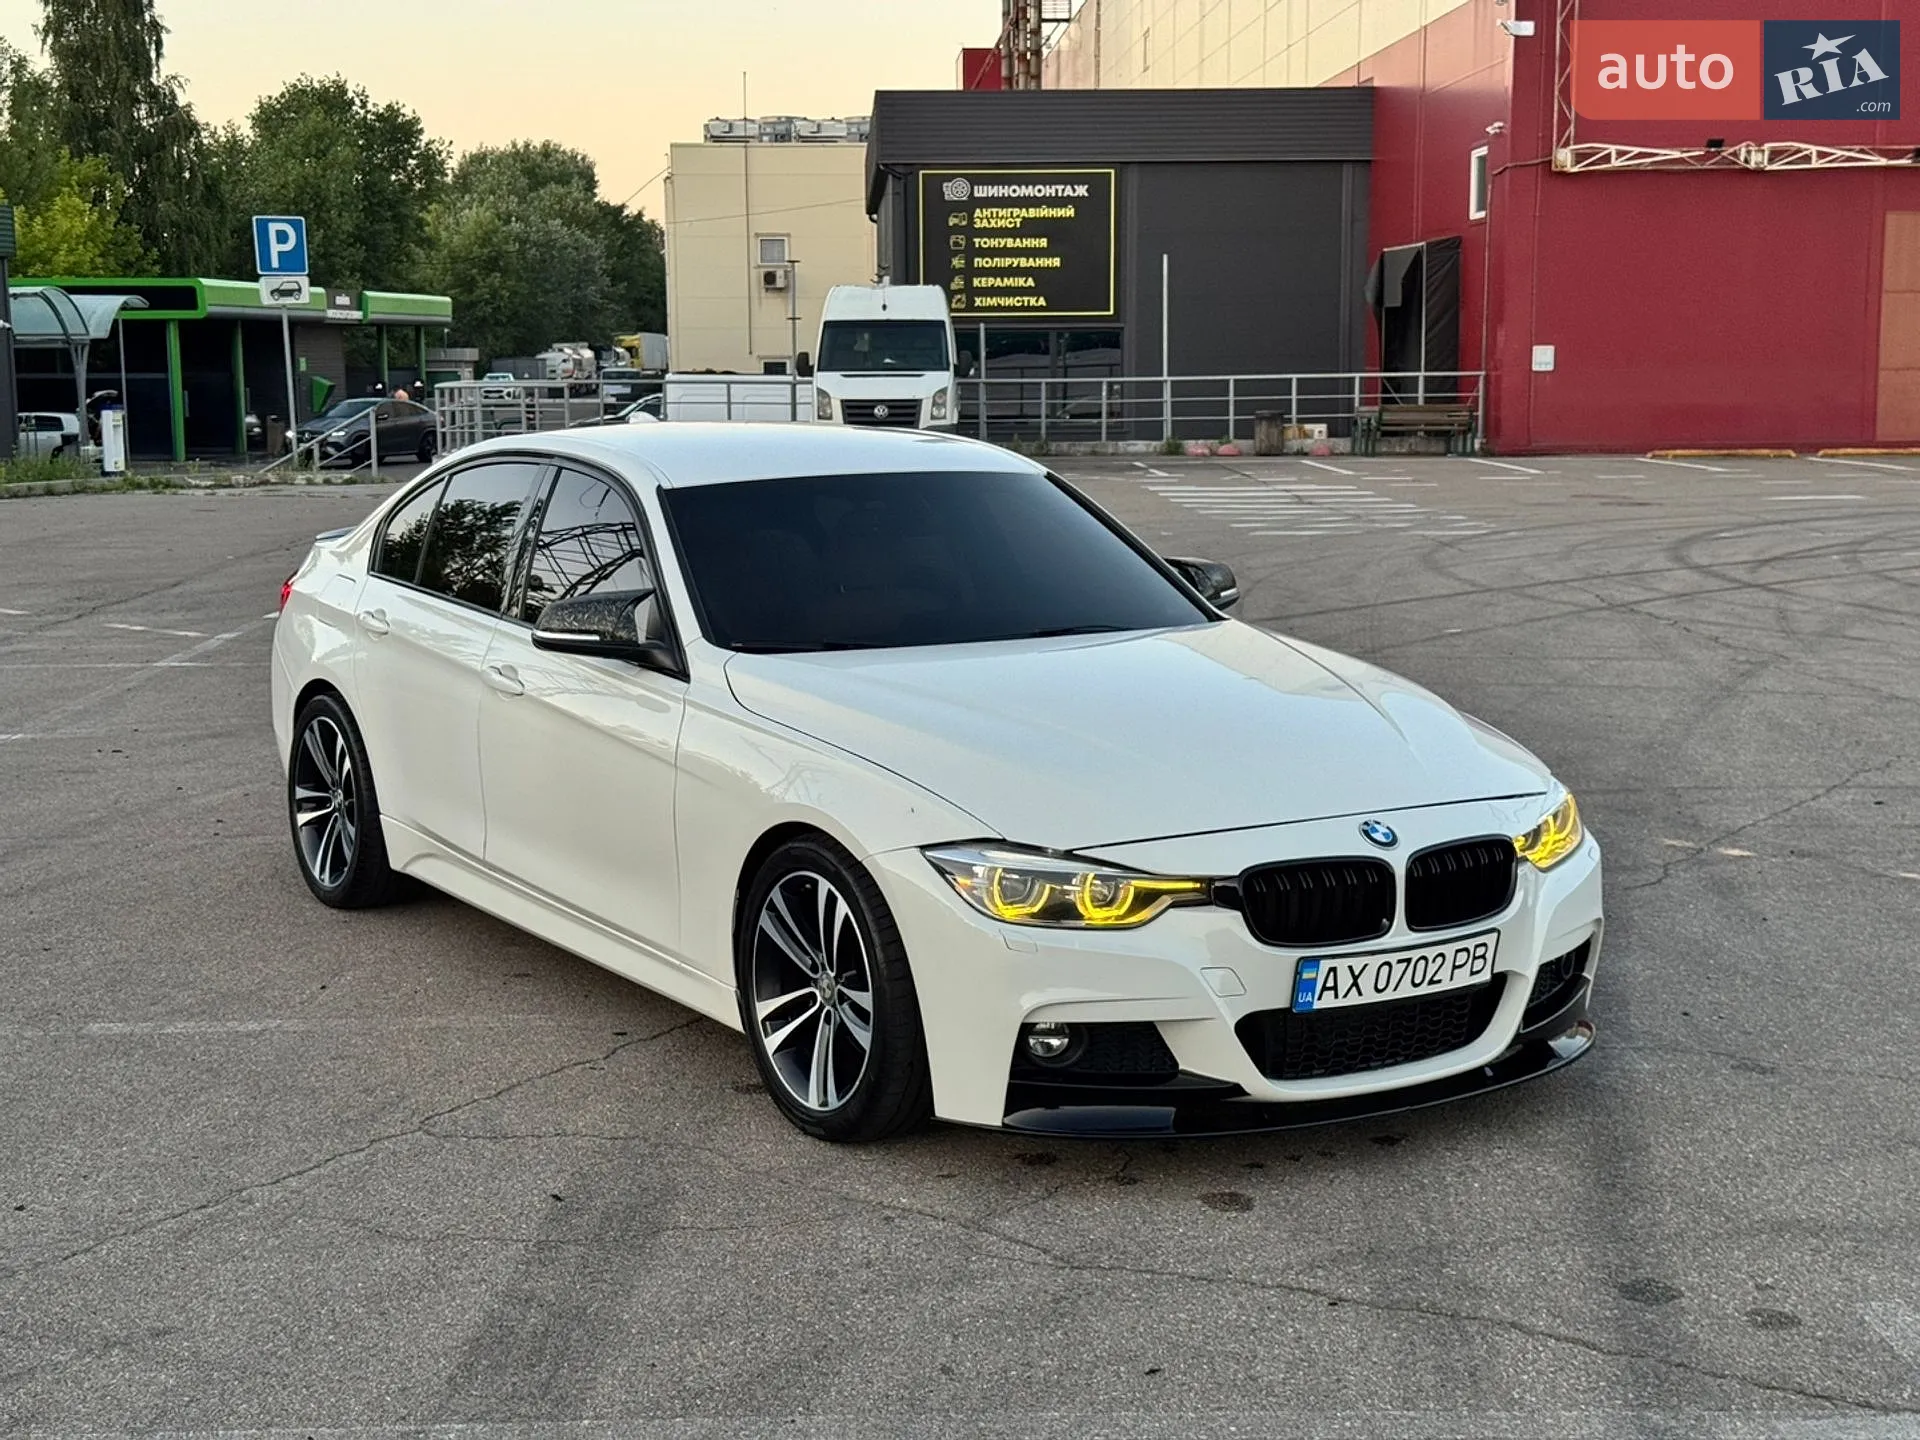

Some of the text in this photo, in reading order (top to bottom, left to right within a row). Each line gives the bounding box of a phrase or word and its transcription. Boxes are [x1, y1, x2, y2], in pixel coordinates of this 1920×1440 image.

[973, 184, 1089, 198] ШИНОМОНТАЖ
[973, 205, 1075, 218] АНТИГРАВІЙНИЙ
[973, 218, 1023, 228] ЗАХИСТ
[267, 221, 297, 269] P
[973, 237, 1048, 248] ТОНУВАННЯ
[973, 257, 1061, 268] ПОЛІРУВАННЯ
[972, 276, 1036, 287] КЕРАМІКА
[974, 296, 1047, 307] ХІМЧИСТКА
[1317, 942, 1489, 1001] AX 0702 PB
[1298, 991, 1313, 1003] UA
